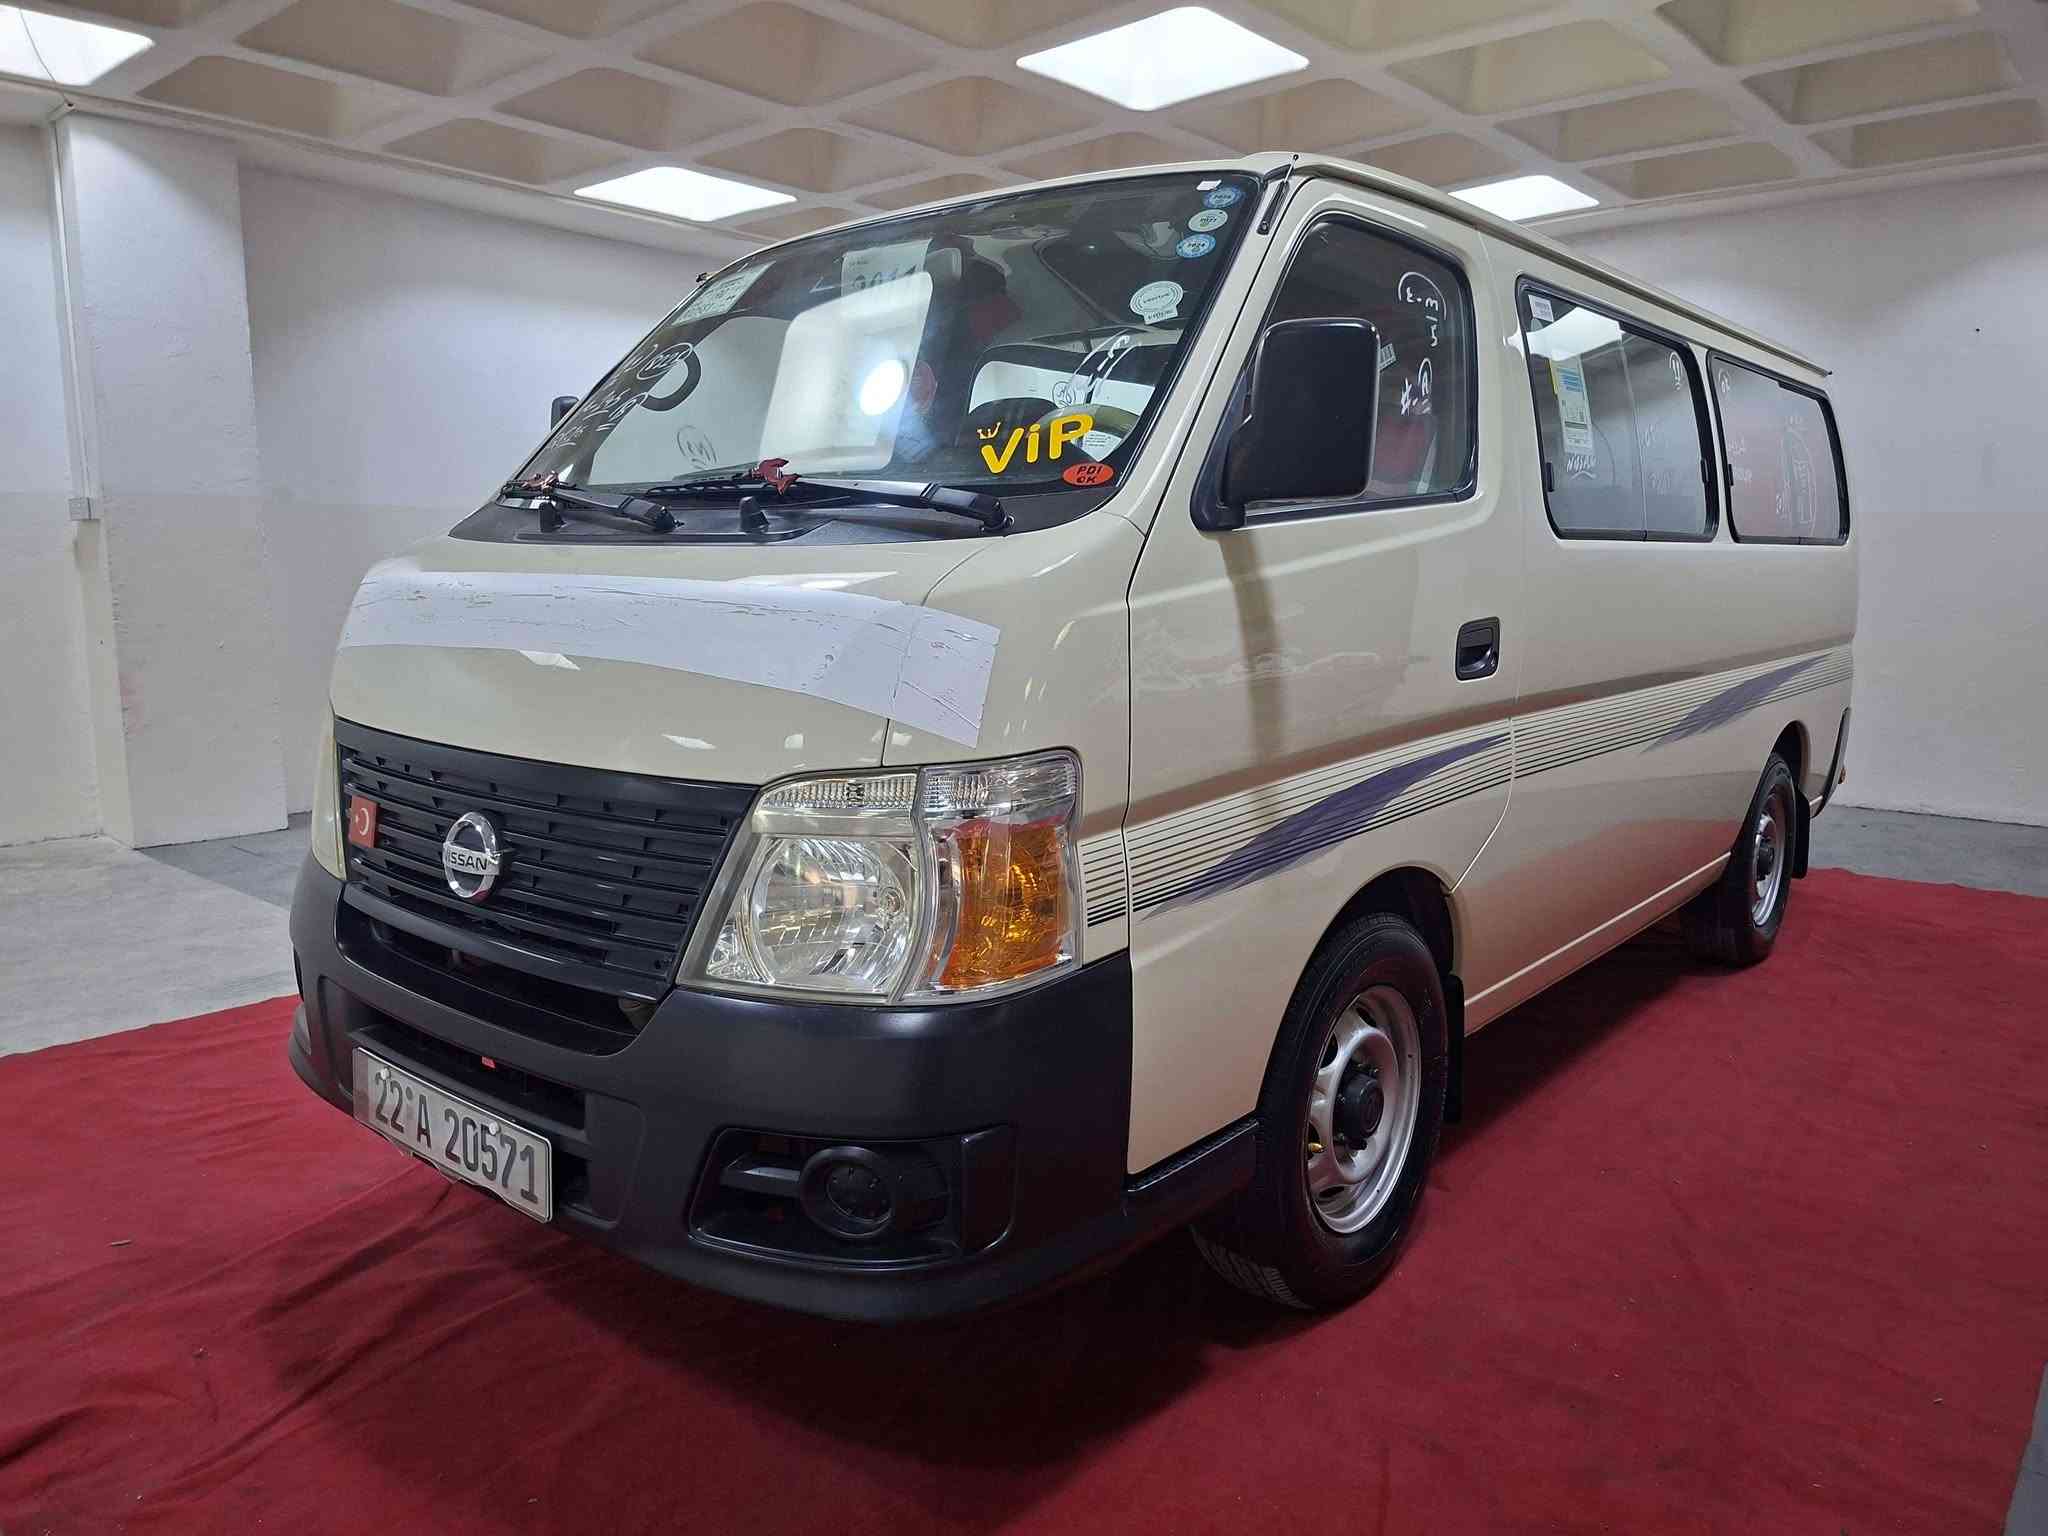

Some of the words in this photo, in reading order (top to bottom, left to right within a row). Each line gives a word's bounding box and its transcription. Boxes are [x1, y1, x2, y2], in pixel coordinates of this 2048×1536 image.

[1076, 465, 1103, 475] PDI
[375, 1068, 404, 1134] 22
[416, 1093, 432, 1149] A
[444, 1107, 540, 1205] 20571
